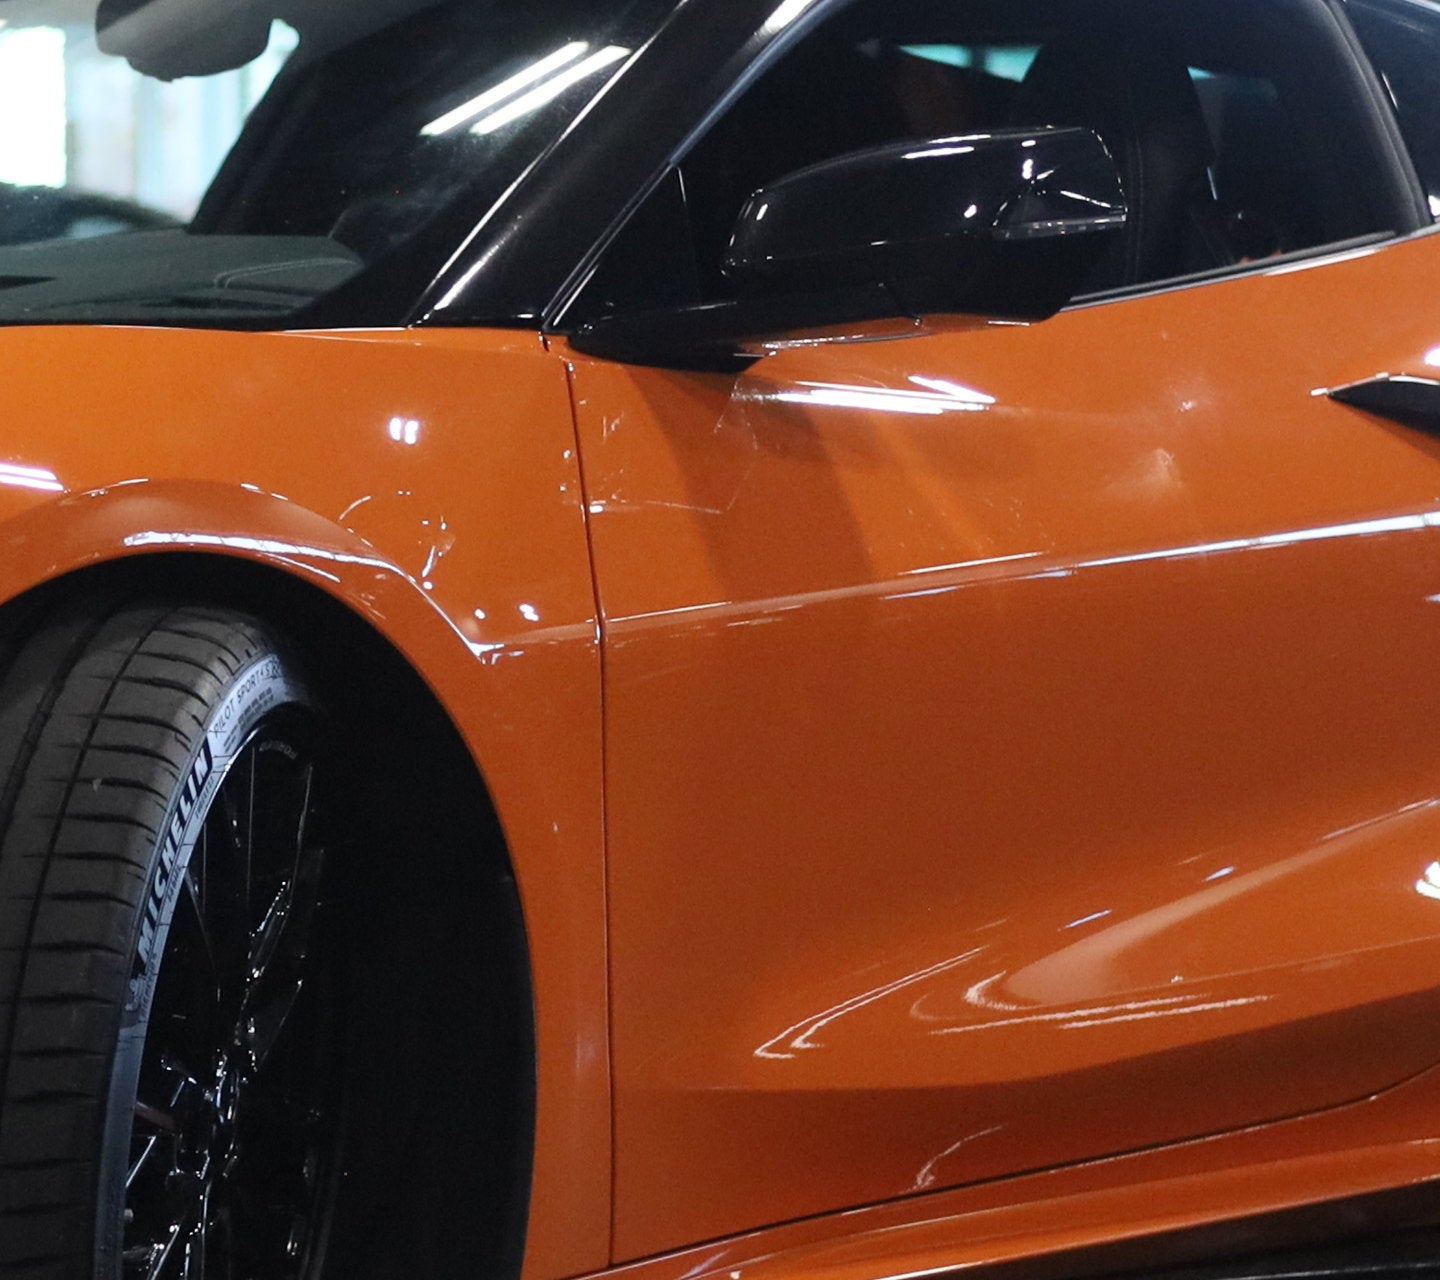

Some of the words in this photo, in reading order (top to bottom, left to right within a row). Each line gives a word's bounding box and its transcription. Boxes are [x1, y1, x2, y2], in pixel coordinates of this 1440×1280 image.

[213, 698, 235, 739] PILOT
[236, 669, 261, 704] SPORT
[137, 747, 209, 965] MICHELIN
